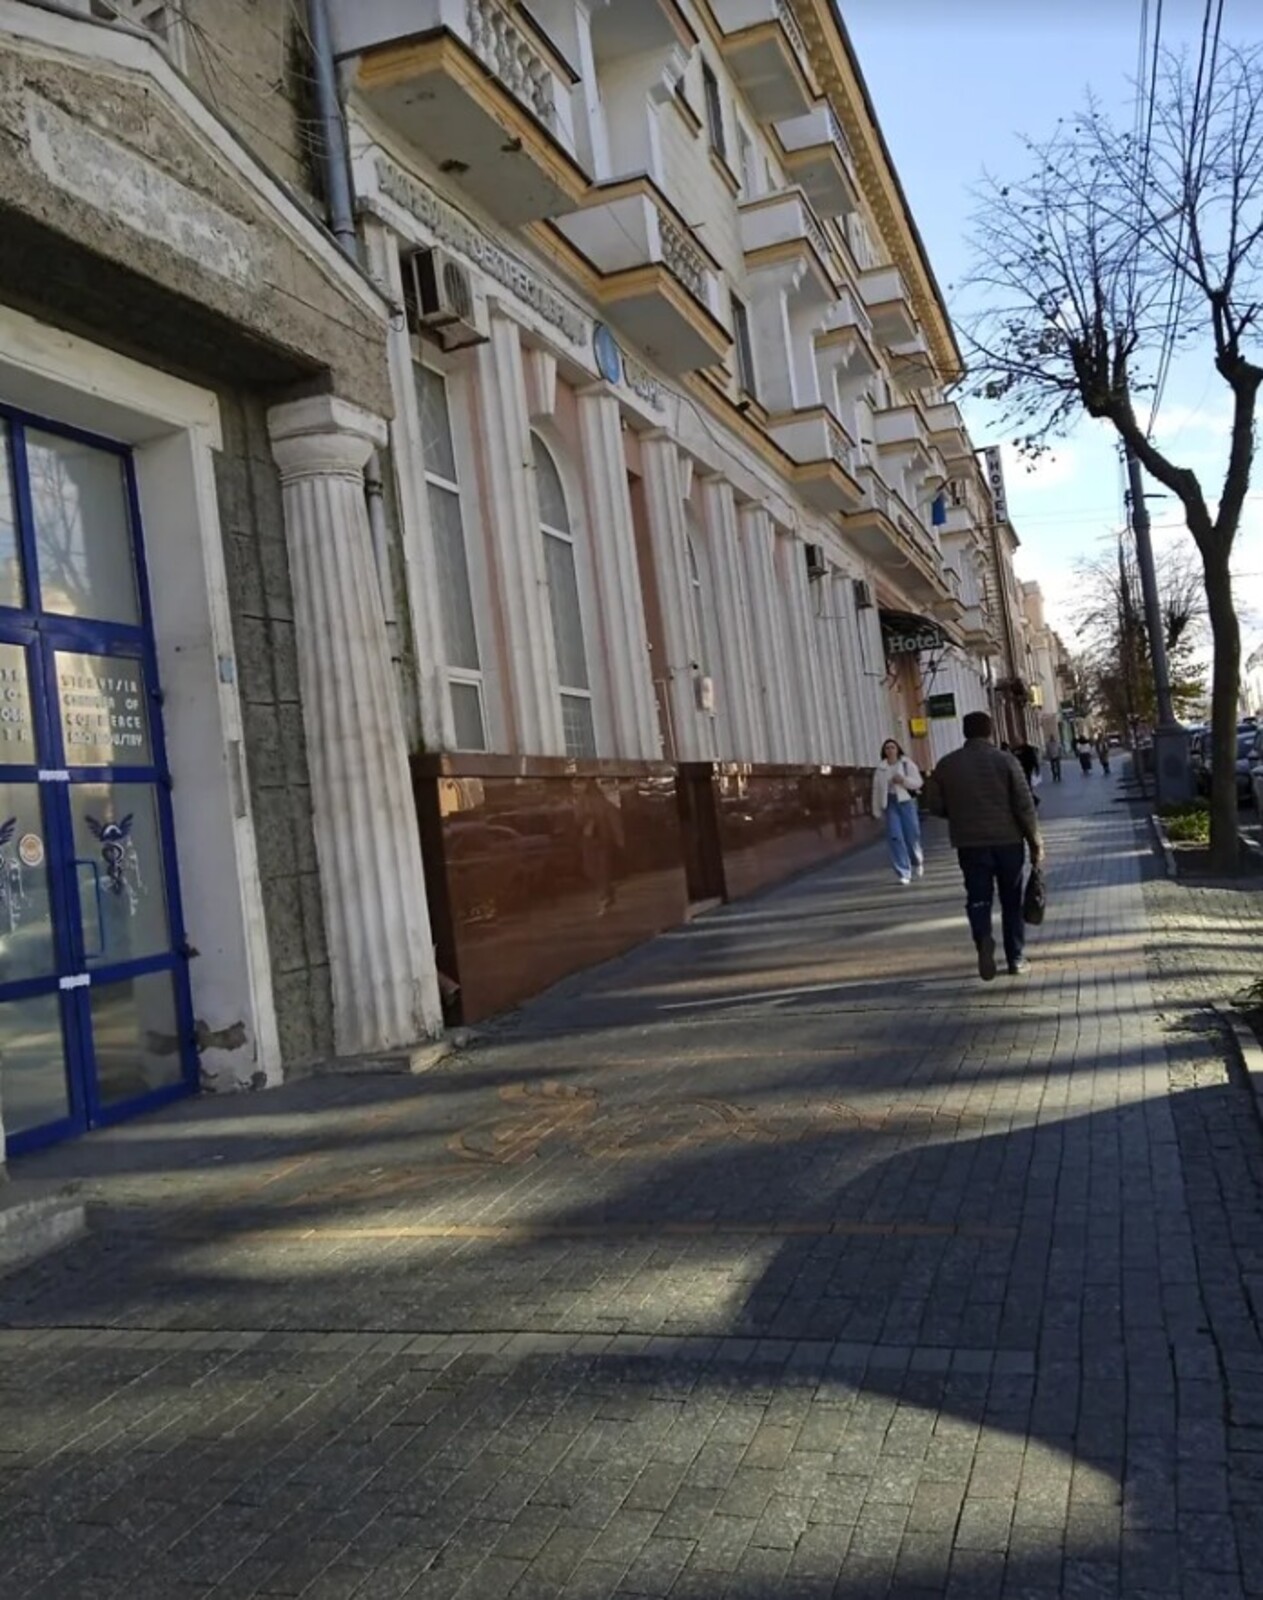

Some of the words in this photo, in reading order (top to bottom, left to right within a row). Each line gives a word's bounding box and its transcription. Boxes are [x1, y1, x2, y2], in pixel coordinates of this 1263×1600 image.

[989, 460, 1006, 524] HOTEL
[888, 629, 943, 654] Hotel
[125, 698, 139, 710] OF
